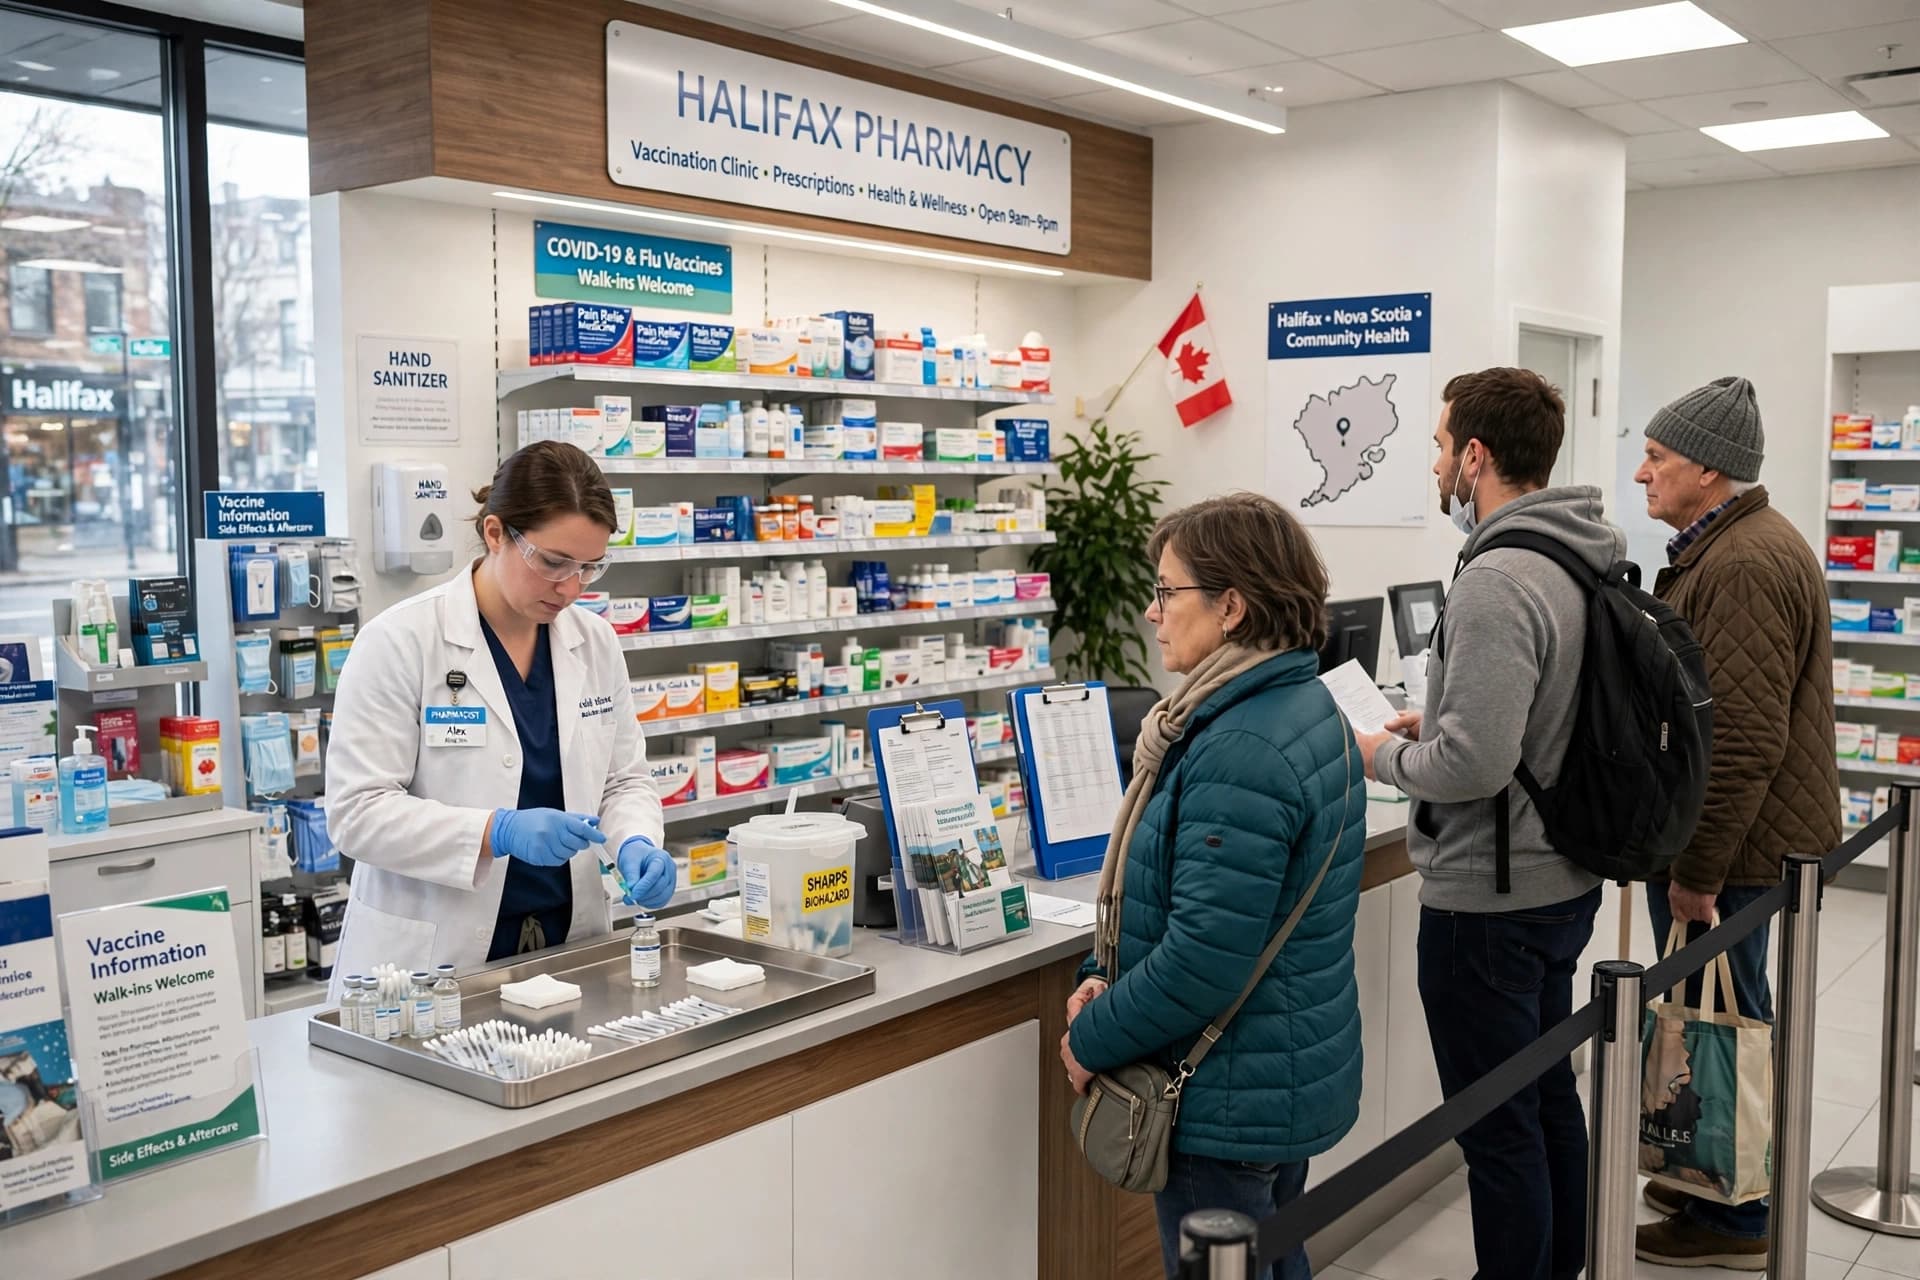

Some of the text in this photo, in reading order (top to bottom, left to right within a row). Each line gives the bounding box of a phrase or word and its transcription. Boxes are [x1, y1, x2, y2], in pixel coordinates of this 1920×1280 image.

[677, 70, 1032, 187] HALIFAX PHARMACY
[631, 139, 717, 174] Vaccination
[721, 154, 759, 180] Clinic
[773, 166, 855, 198] Prescriptions
[868, 183, 906, 207] Health
[909, 191, 918, 207] &
[920, 192, 968, 217] Wellness
[978, 203, 1006, 227] Open
[547, 237, 723, 276] COVID-19 & Flu Vaccines
[577, 268, 695, 297] Walk-ins Welcome
[577, 307, 599, 320] Pain
[1277, 305, 1413, 329] Halifax Nova Scotia
[1286, 327, 1410, 349] Community Health
[389, 351, 432, 368] HAND
[373, 370, 448, 389] SANITIZER
[12, 379, 115, 413] Halifax
[218, 495, 265, 509] Vaccine
[218, 508, 290, 522] Information
[218, 524, 237, 534] Side
[239, 523, 267, 534] Effects
[268, 523, 275, 533] &
[447, 725, 467, 736] Alex
[807, 870, 848, 892] SHARPS
[805, 888, 850, 909] BIOHAZARD
[86, 928, 165, 957] Vaccine
[90, 941, 207, 980] Information
[93, 967, 215, 1005] Walk-ins Welcome
[109, 1120, 239, 1168] Side Effects & Aftercare
